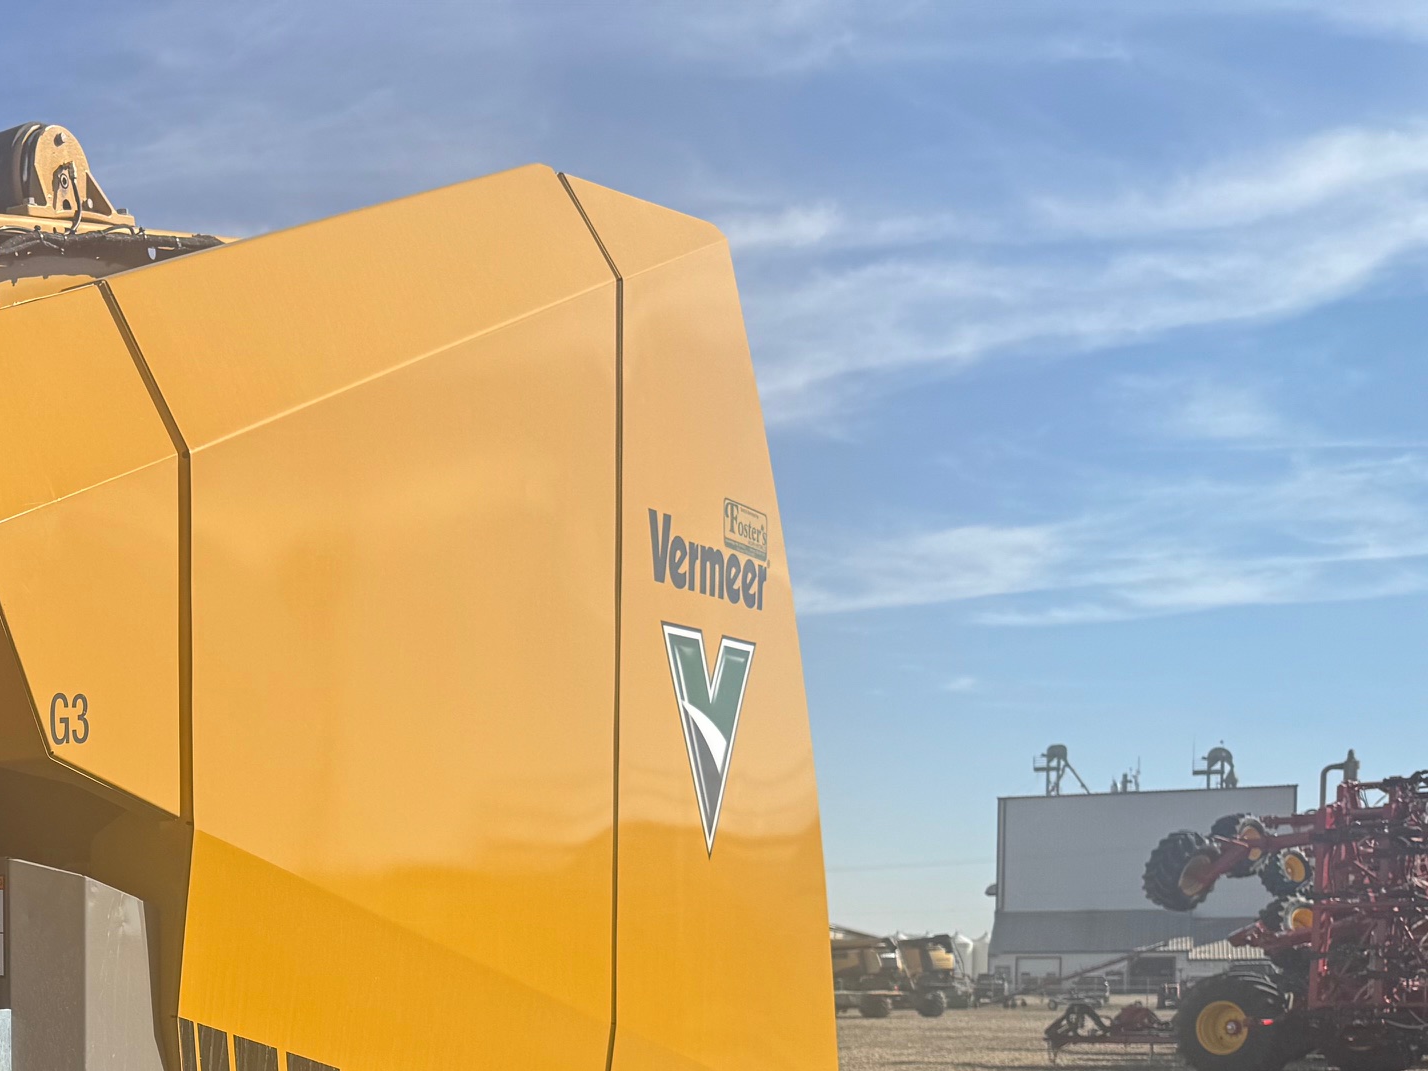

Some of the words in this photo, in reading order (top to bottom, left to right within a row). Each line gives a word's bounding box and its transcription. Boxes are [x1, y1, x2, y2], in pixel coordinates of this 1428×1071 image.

[725, 502, 767, 546] Foster's
[648, 508, 767, 611] Vermeer
[50, 692, 89, 745] G3
